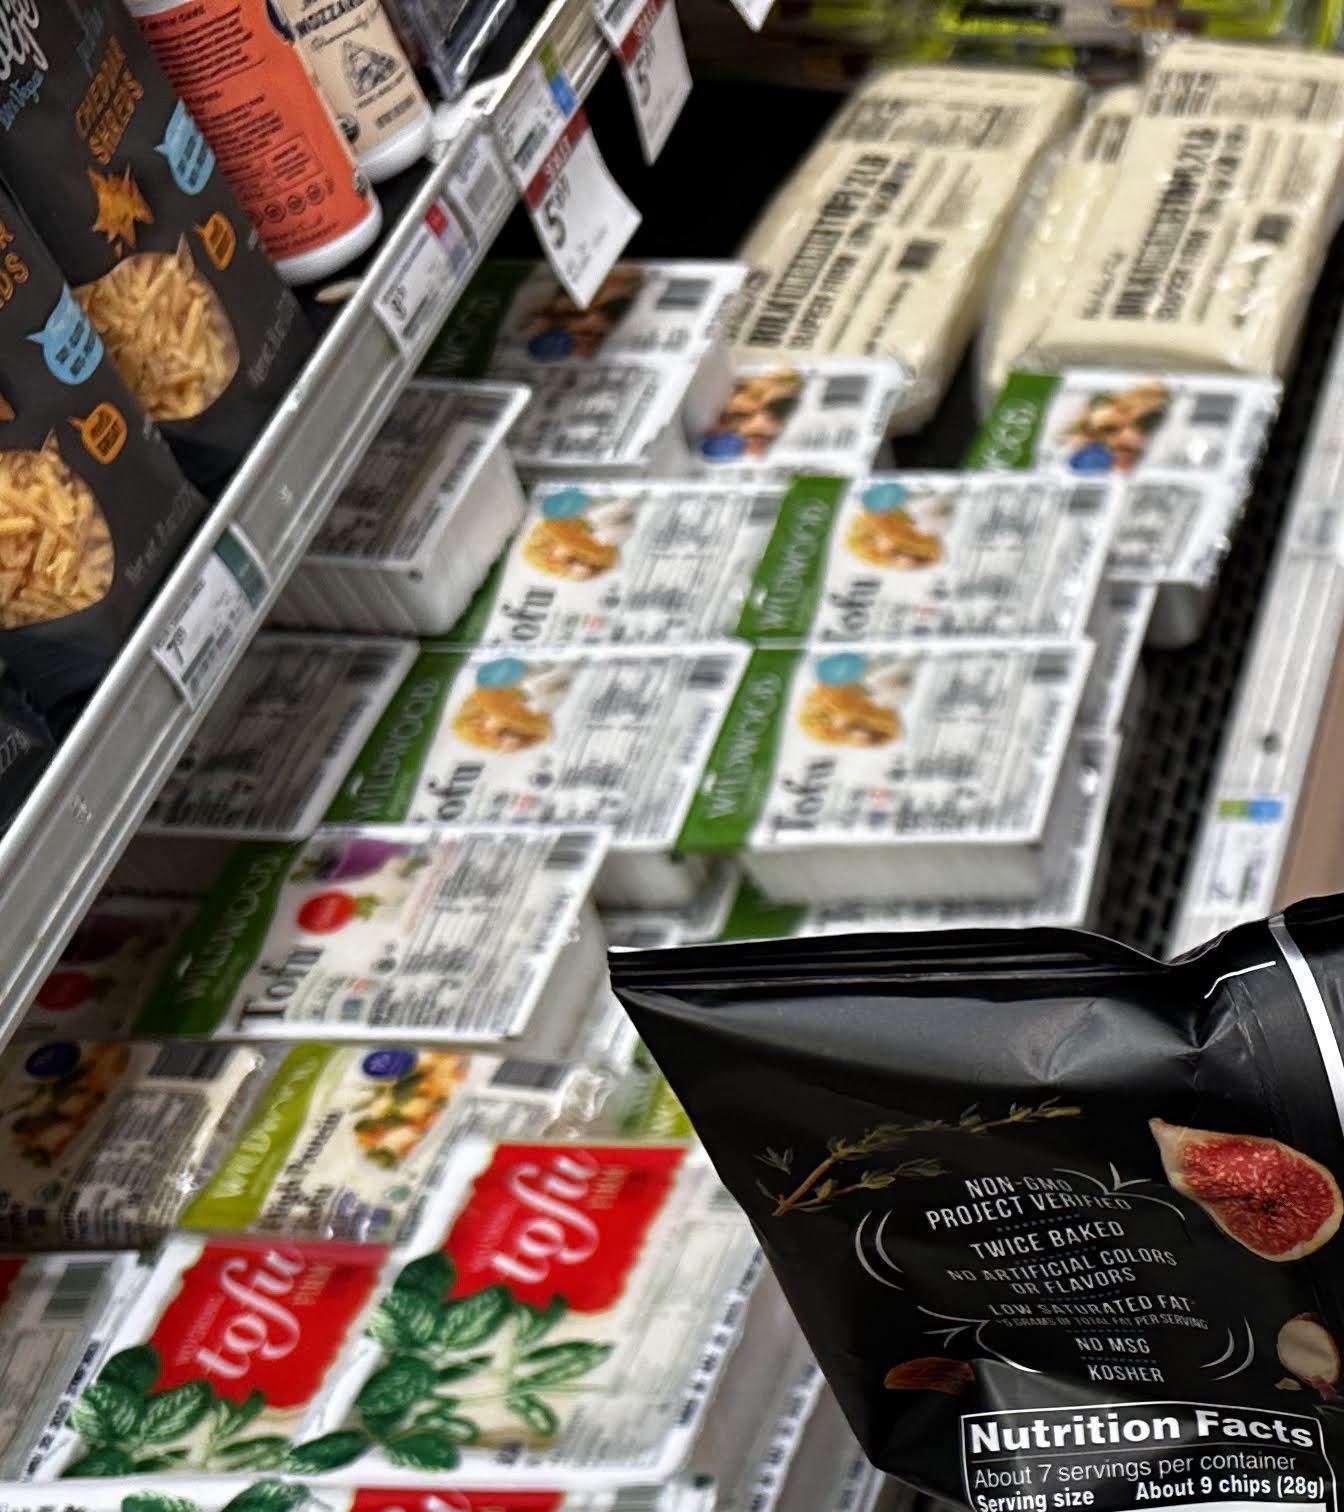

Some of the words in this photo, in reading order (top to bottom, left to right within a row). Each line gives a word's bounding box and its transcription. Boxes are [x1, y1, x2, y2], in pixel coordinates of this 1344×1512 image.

[964, 1175, 1073, 1199] NON-GMO
[490, 1150, 600, 1284] tofu
[924, 1196, 1025, 1231] PROJECT
[1033, 1191, 1132, 1212] VERIFIED
[968, 1232, 1045, 1260] TWICE
[1048, 1220, 1126, 1249] BAKED
[982, 1253, 1097, 1283] ARTIFICIAL
[1100, 1247, 1179, 1267] COLORS
[1011, 1281, 1041, 1296] OR
[1045, 1266, 1137, 1295] FLAVORS
[196, 1246, 306, 1379] tofu
[988, 1303, 1033, 1317] LOW
[1040, 1294, 1154, 1316] SATURATED
[1074, 1336, 1105, 1353] NO
[1108, 1337, 1151, 1355] MSG
[1087, 1364, 1166, 1384] KOSHER
[970, 1413, 1181, 1455] Nutrition
[1194, 1408, 1314, 1450] Facts
[973, 1467, 1034, 1490] About
[1038, 1464, 1053, 1483] 7
[1058, 1458, 1153, 1486] servings
[1158, 1456, 1195, 1480] per
[1200, 1452, 1298, 1473] container
[1054, 1487, 1096, 1508] size
[1135, 1477, 1195, 1502] About
[1200, 1476, 1213, 1495] 9
[1219, 1473, 1272, 1498] chips
[1277, 1474, 1326, 1500] (28g)
